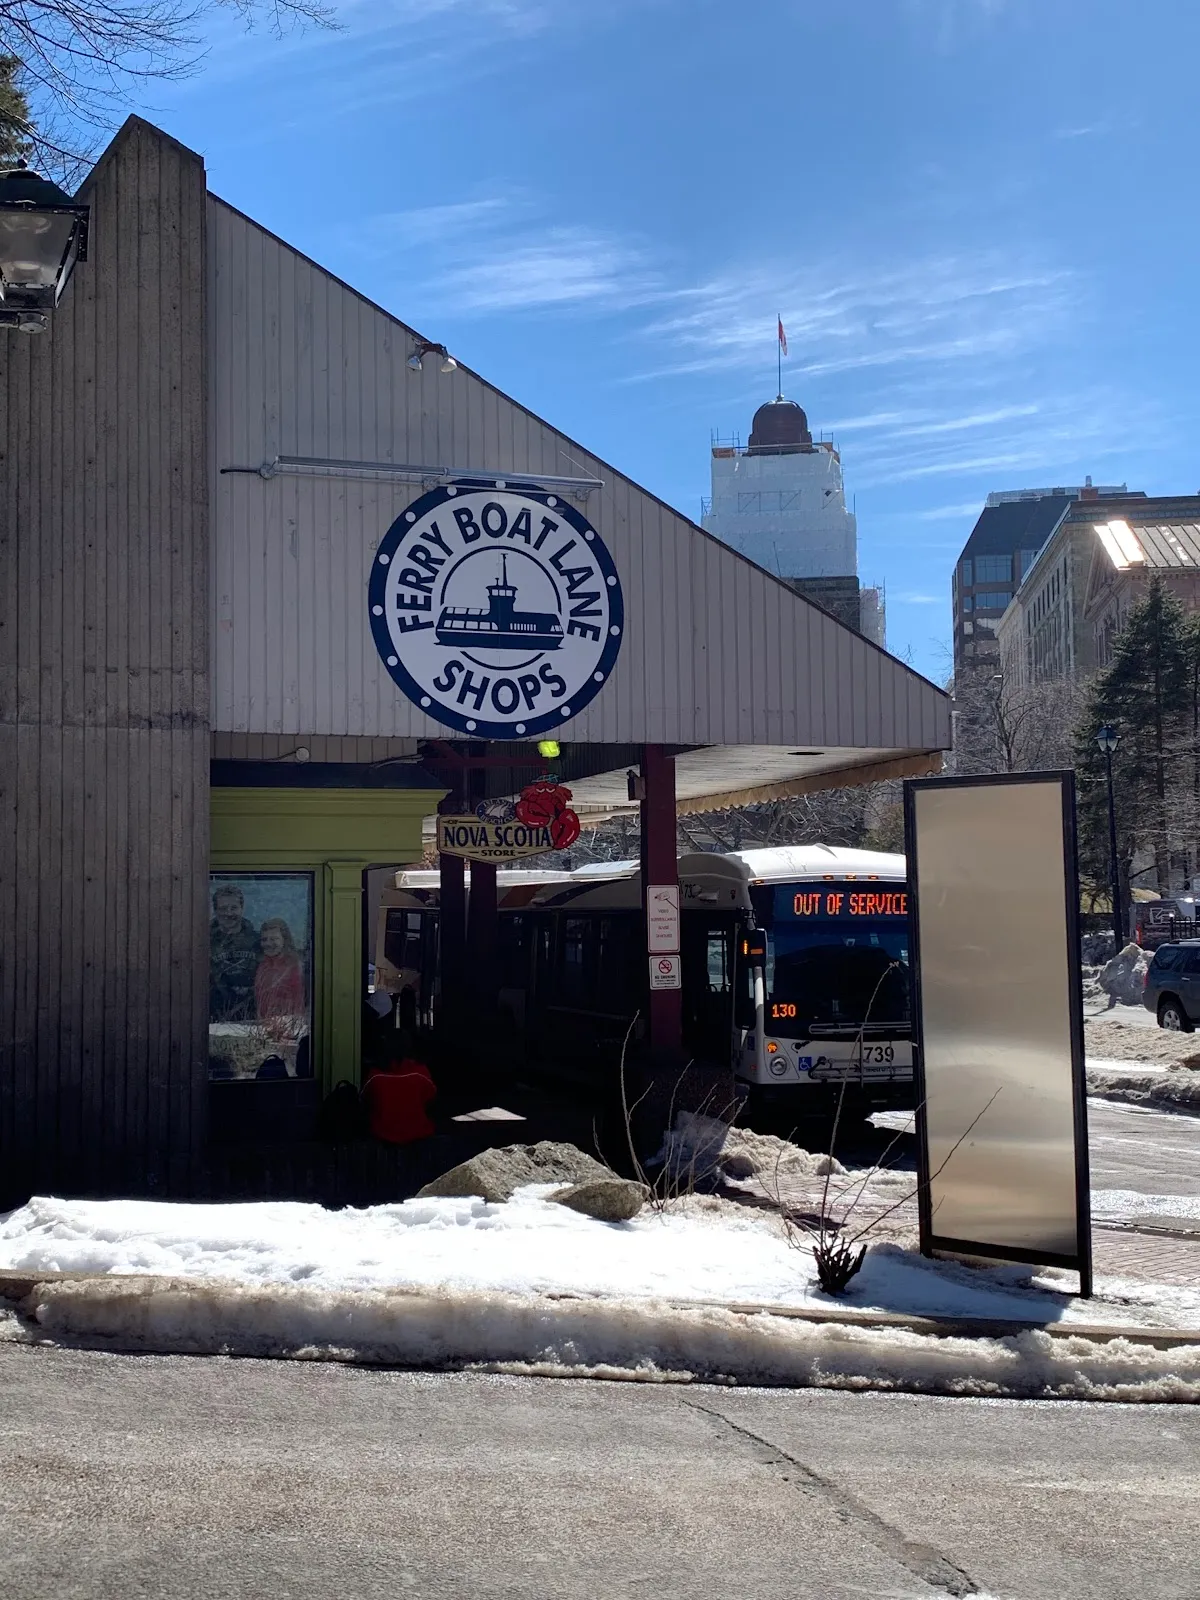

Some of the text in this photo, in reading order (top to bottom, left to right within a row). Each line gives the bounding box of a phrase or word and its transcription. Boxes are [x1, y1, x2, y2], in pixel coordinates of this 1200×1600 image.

[397, 501, 603, 642] FERRY BOAT LANE
[432, 659, 567, 714] SHOPS
[443, 826, 552, 847] NOVA SCOTIA
[793, 893, 909, 915] OUT OF SERVICE
[771, 1003, 797, 1018] 130
[863, 1046, 894, 1063] 739
